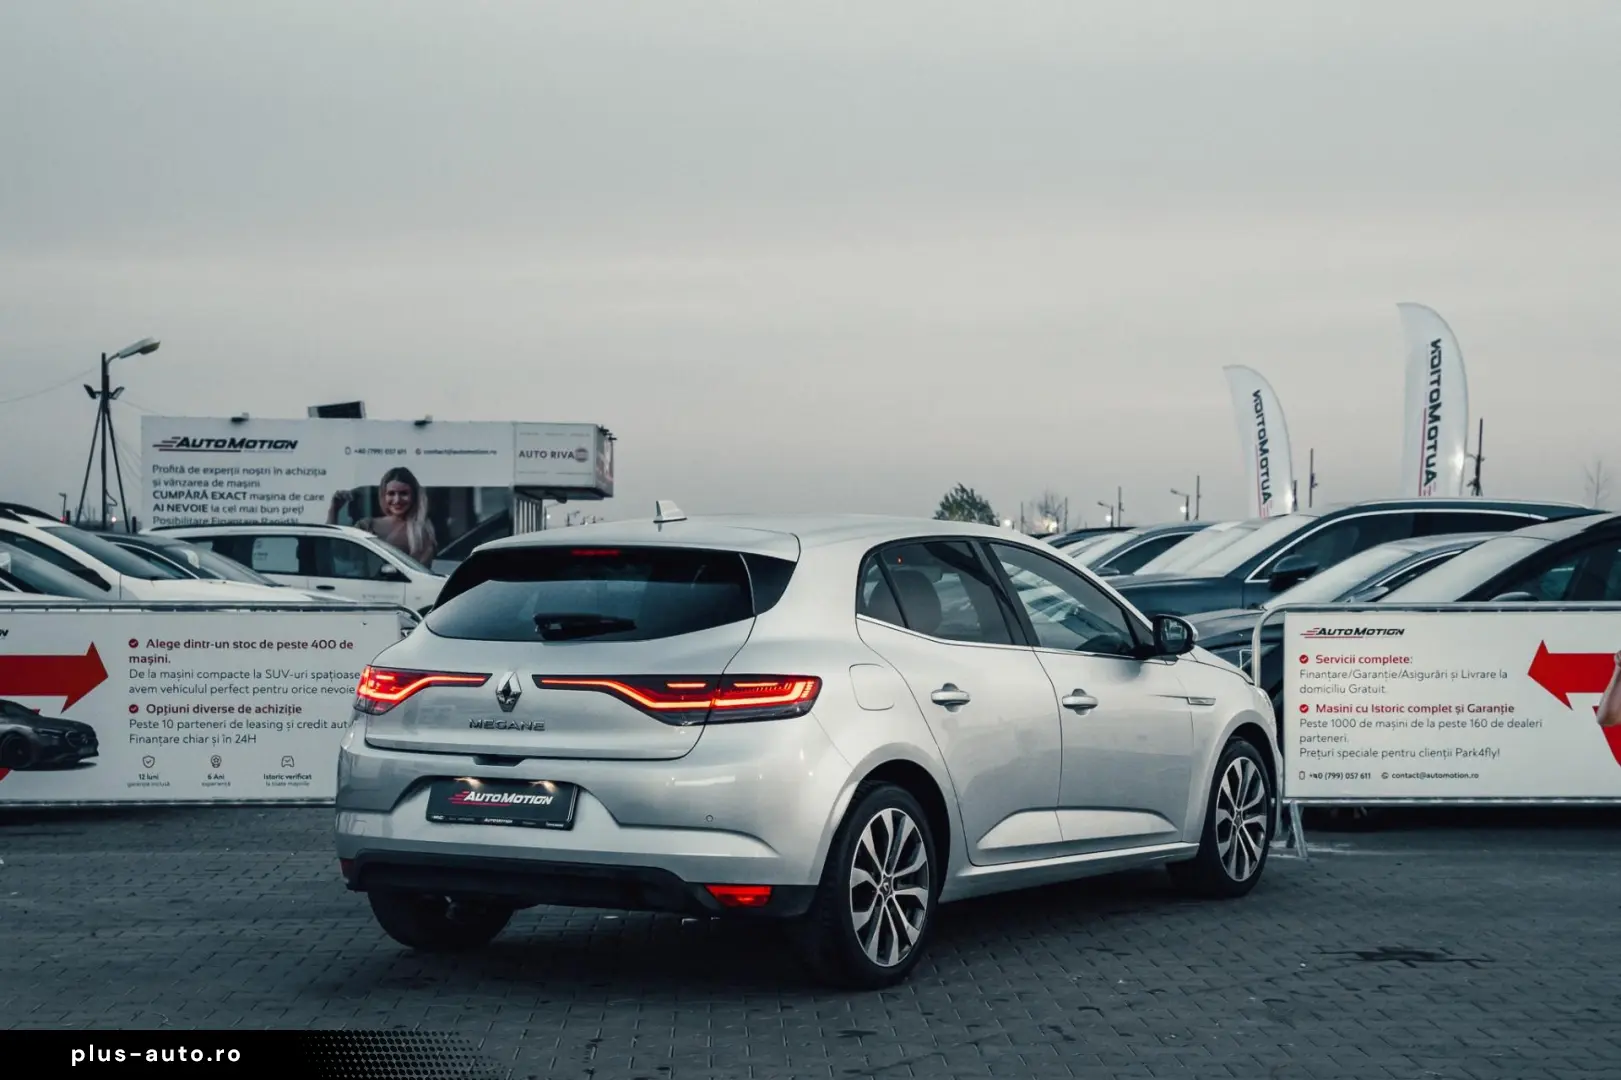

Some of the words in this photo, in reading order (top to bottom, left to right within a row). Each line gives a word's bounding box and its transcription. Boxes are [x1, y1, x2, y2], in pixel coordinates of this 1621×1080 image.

[175, 437, 298, 450] AUTOMOTION
[519, 450, 547, 458] AUTO
[551, 451, 574, 459] RIVA
[152, 464, 185, 474] Profită
[188, 466, 200, 474] de
[203, 467, 240, 476] experții
[242, 467, 271, 476] noștri
[274, 467, 282, 475] în
[285, 467, 326, 477] achiziția
[153, 491, 208, 500] CUMPĂRĂ
[211, 492, 247, 500] EXACT
[250, 494, 286, 502] mașina
[288, 493, 301, 501] de
[153, 504, 164, 512] AI
[167, 504, 208, 512] NEVOIE
[261, 505, 279, 513] bun
[282, 505, 304, 515] preț!
[146, 639, 180, 651] Alege
[184, 639, 229, 649] dintr-un
[233, 640, 256, 649] stoc
[260, 639, 273, 649] de
[277, 641, 308, 651] peste
[311, 640, 336, 649] 400
[340, 639, 353, 649] de
[129, 654, 171, 666] mașini.
[1316, 655, 1355, 664] Servicii
[1359, 655, 1413, 665] complete:
[129, 670, 144, 679] De
[148, 670, 156, 679] la
[160, 670, 194, 682] mașini
[197, 670, 250, 681] compacte
[253, 670, 262, 679] la
[266, 670, 308, 679] SUV-uri
[1300, 669, 1447, 681] Finanțare/Garanție/Asigurări
[1451, 670, 1458, 681] și
[1461, 669, 1496, 680] Livrare
[1500, 669, 1508, 680] la
[129, 686, 157, 694] avem
[160, 685, 207, 694] vehiculul
[210, 685, 249, 696] perfect
[253, 686, 288, 696] pentru
[292, 686, 317, 694] orice
[321, 686, 354, 694] nevoie
[146, 704, 190, 716] Opțiuni
[193, 704, 235, 714] diverse
[238, 704, 252, 714] de
[255, 704, 302, 716] achiziție
[1316, 704, 1353, 713] Masini
[1372, 704, 1405, 713] Istoric
[1408, 704, 1452, 715] complet
[1455, 705, 1464, 715] și
[1468, 704, 1514, 715] Garanție
[129, 720, 159, 729] Peste
[162, 720, 173, 729] 10
[177, 720, 226, 731] parteneri
[230, 719, 243, 729] de
[246, 719, 283, 731] leasing
[287, 719, 294, 731] și
[297, 720, 328, 729] credit
[468, 719, 545, 731] MEGANE
[1300, 719, 1328, 728] Peste
[1331, 719, 1356, 728] 1000
[1360, 719, 1372, 728] de
[1375, 719, 1408, 730] mașini
[1411, 719, 1424, 728] de
[1427, 719, 1436, 728] la
[1439, 720, 1467, 730] peste
[1470, 719, 1488, 728] 160
[1491, 719, 1504, 728] de
[1507, 719, 1542, 728] dealeri
[129, 734, 180, 747] Finanțare
[183, 734, 208, 744] chiar
[212, 734, 220, 746] și
[222, 734, 232, 744] în
[235, 735, 256, 744] 24H
[1300, 733, 1348, 744] parteneri.
[1300, 749, 1334, 759] Prețuri
[1337, 748, 1378, 759] speciale
[1381, 750, 1416, 759] pentru
[1419, 748, 1452, 759] clienții
[1456, 748, 1500, 759] Park4fly!
[1392, 772, 1479, 780] contact@automotion.ro
[464, 792, 553, 805] AUTOMOTION
